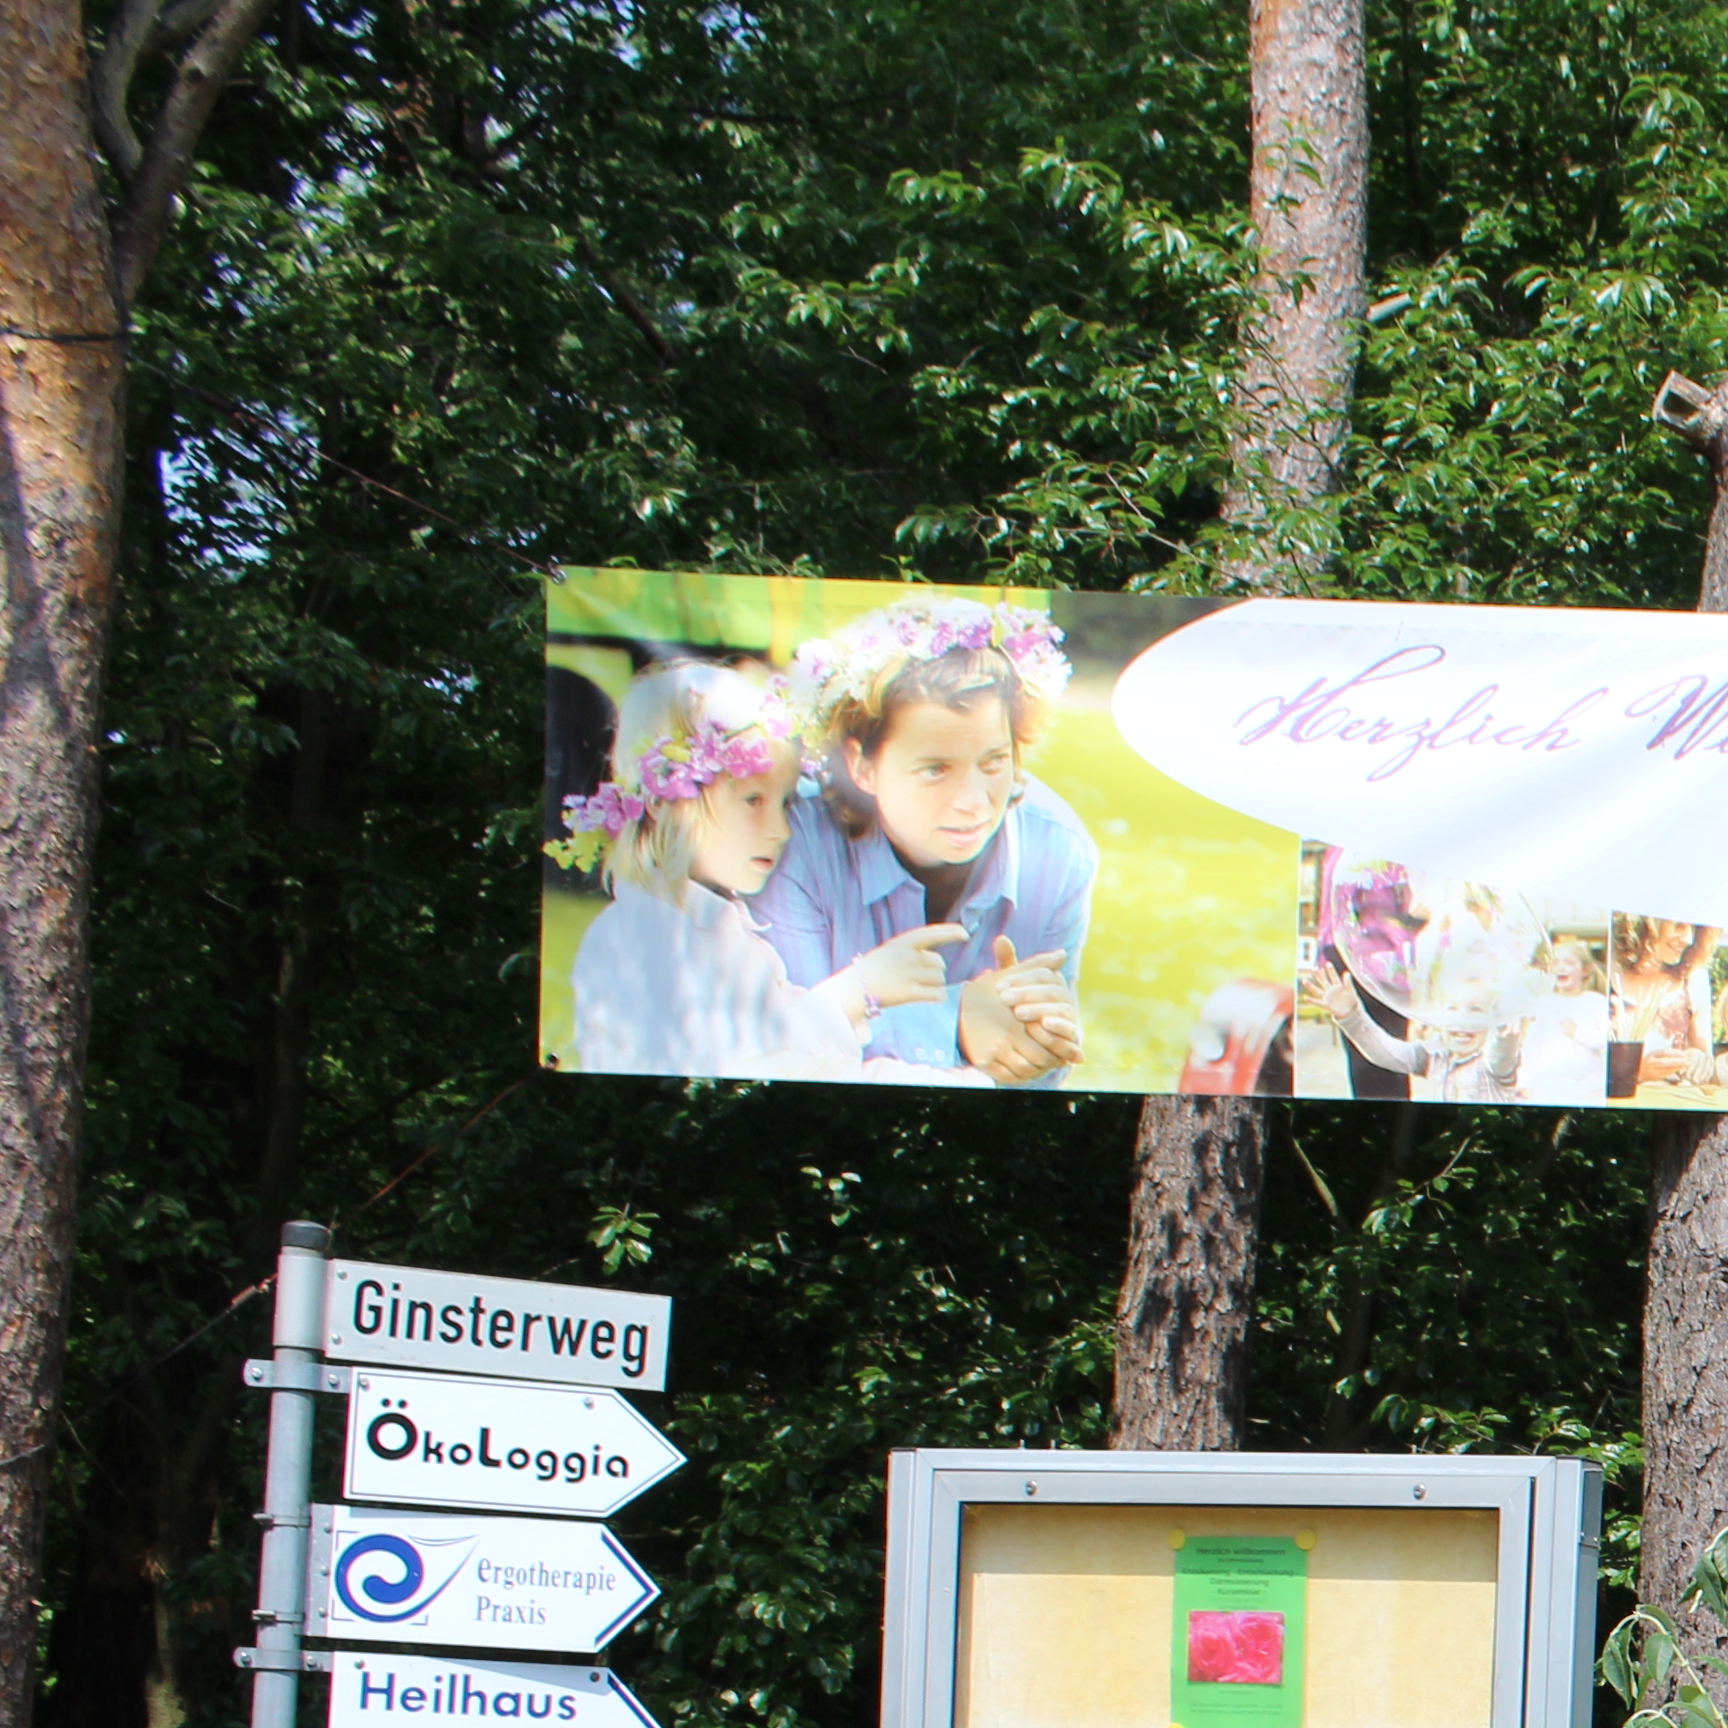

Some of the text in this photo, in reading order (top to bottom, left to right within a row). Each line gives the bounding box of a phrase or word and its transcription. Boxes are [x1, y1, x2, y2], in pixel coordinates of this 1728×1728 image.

[1233, 644, 1610, 782] Herzlich
[353, 1279, 650, 1378] Ginsterweg
[366, 1397, 630, 1484] ÖkoLoggia
[475, 1595, 547, 1625] Praxis
[359, 1671, 578, 1722] Heilhaus
